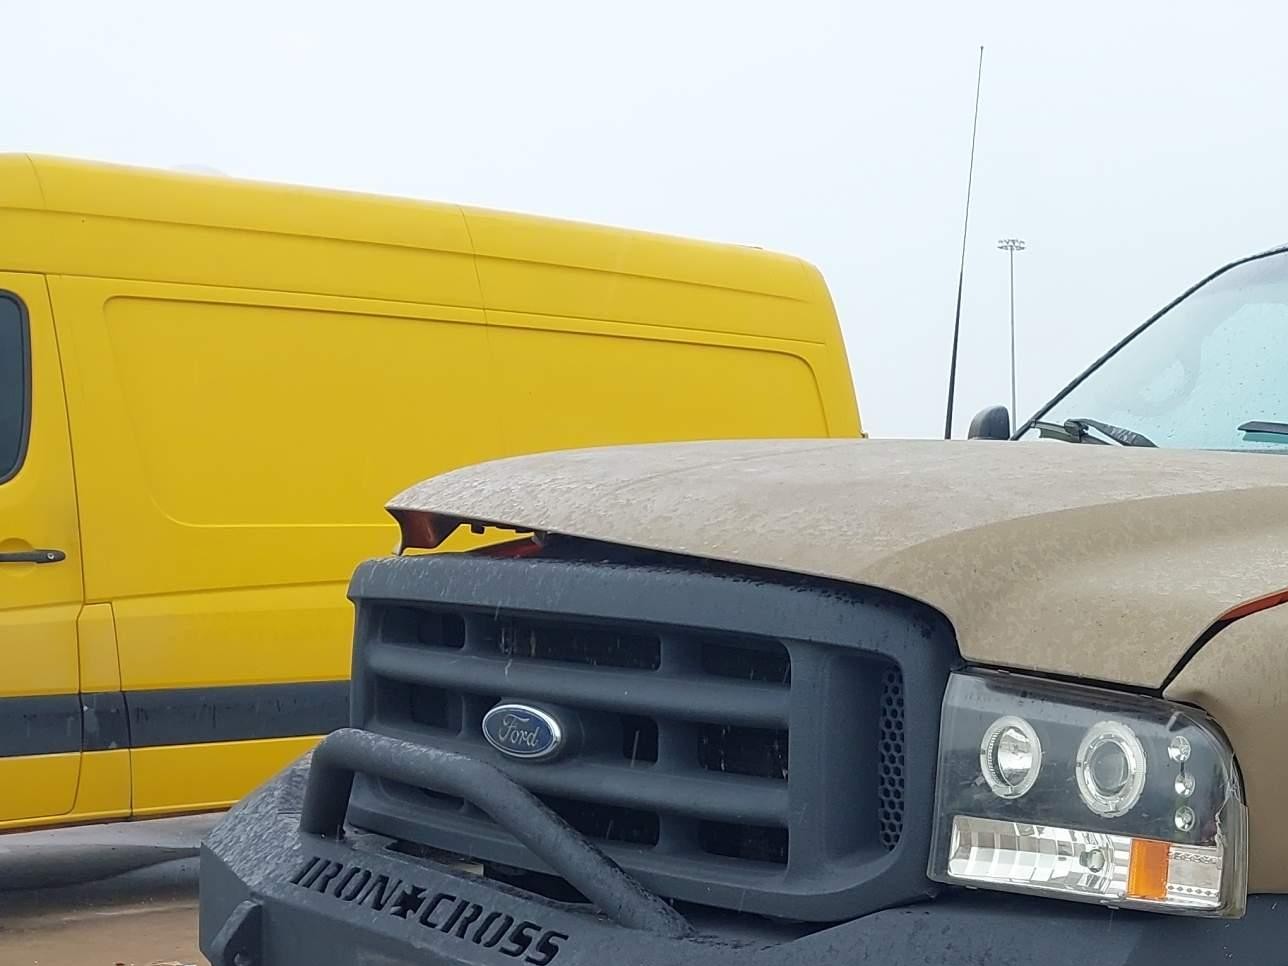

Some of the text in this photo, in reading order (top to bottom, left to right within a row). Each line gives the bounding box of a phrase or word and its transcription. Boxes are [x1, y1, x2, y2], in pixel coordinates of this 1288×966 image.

[498, 713, 540, 747] Ford
[290, 855, 570, 966] IRON CROSS
